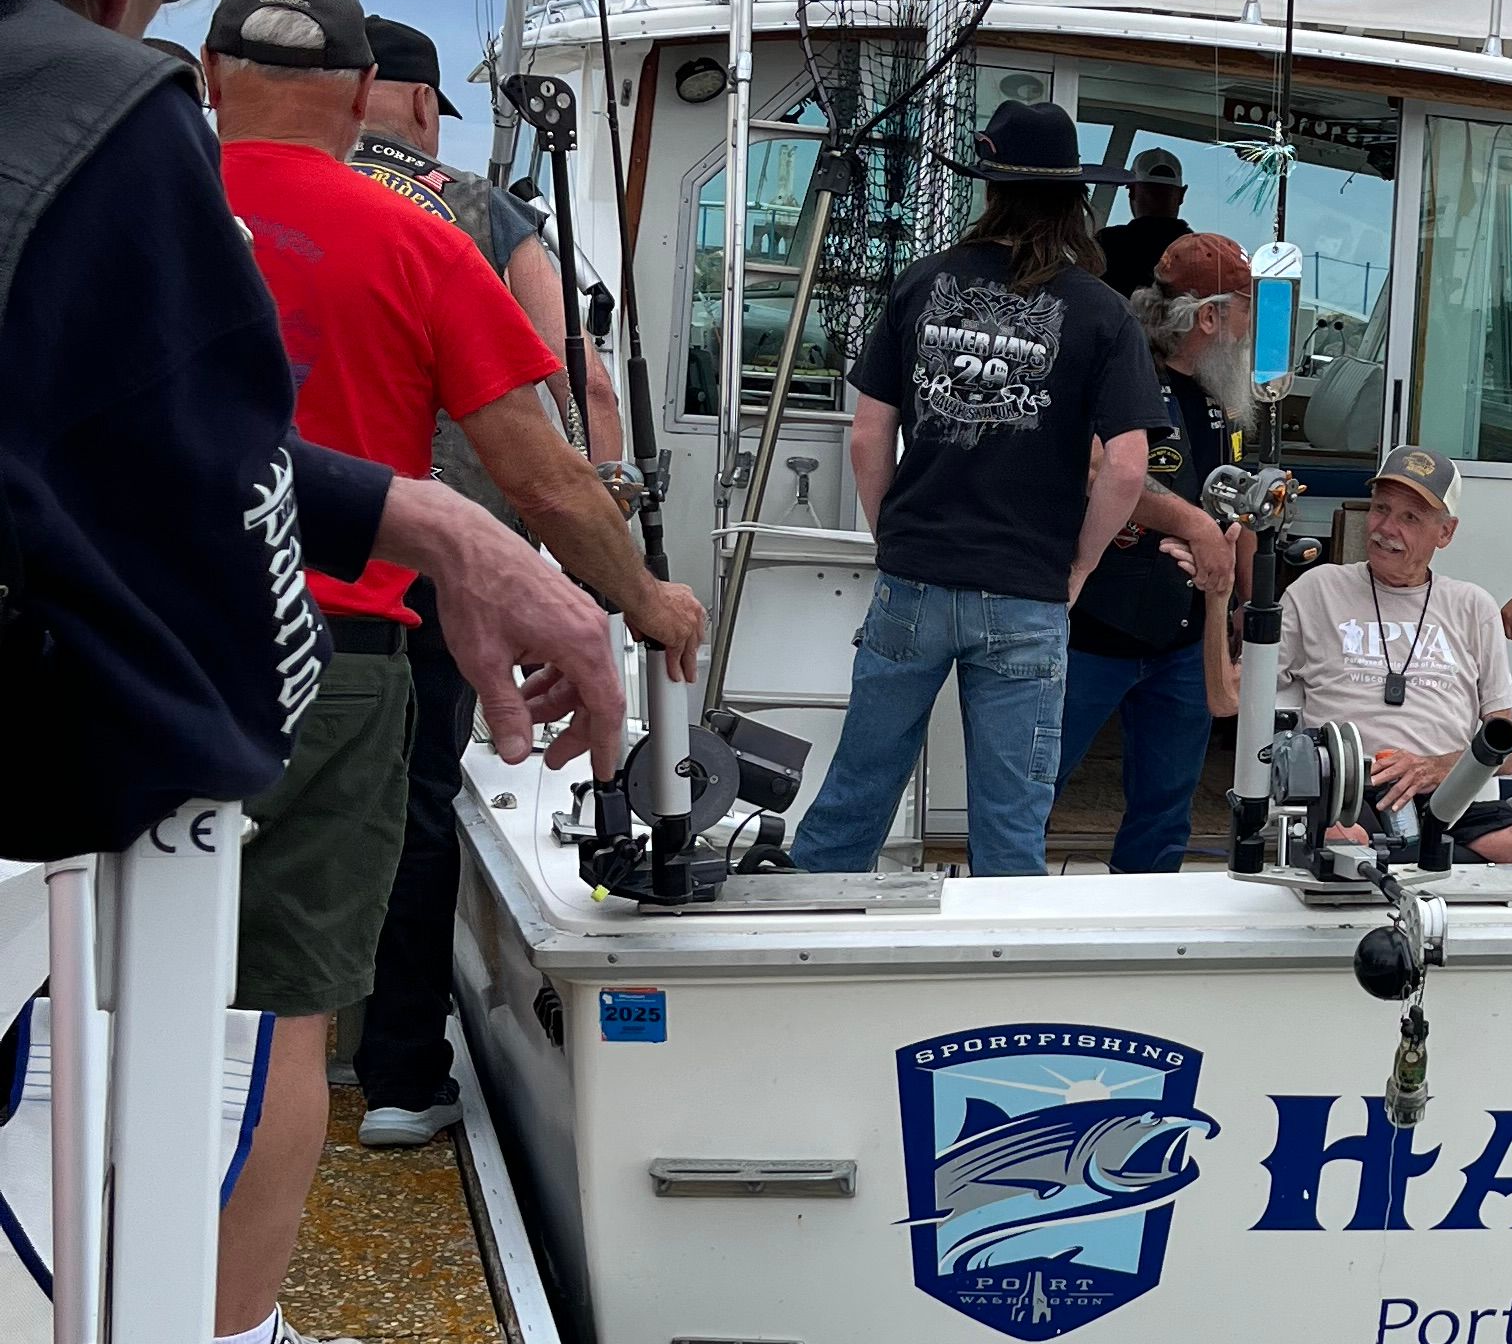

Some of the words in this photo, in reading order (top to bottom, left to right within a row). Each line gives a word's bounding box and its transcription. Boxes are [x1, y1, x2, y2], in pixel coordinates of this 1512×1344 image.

[371, 144, 426, 167] CORPS
[924, 324, 990, 356] BIKER
[992, 335, 1047, 368] DAYS
[1364, 620, 1458, 666] PVA
[605, 1006, 661, 1022] 2025
[915, 1033, 1185, 1066] SPORTFISHING
[975, 1277, 1094, 1291] PORT
